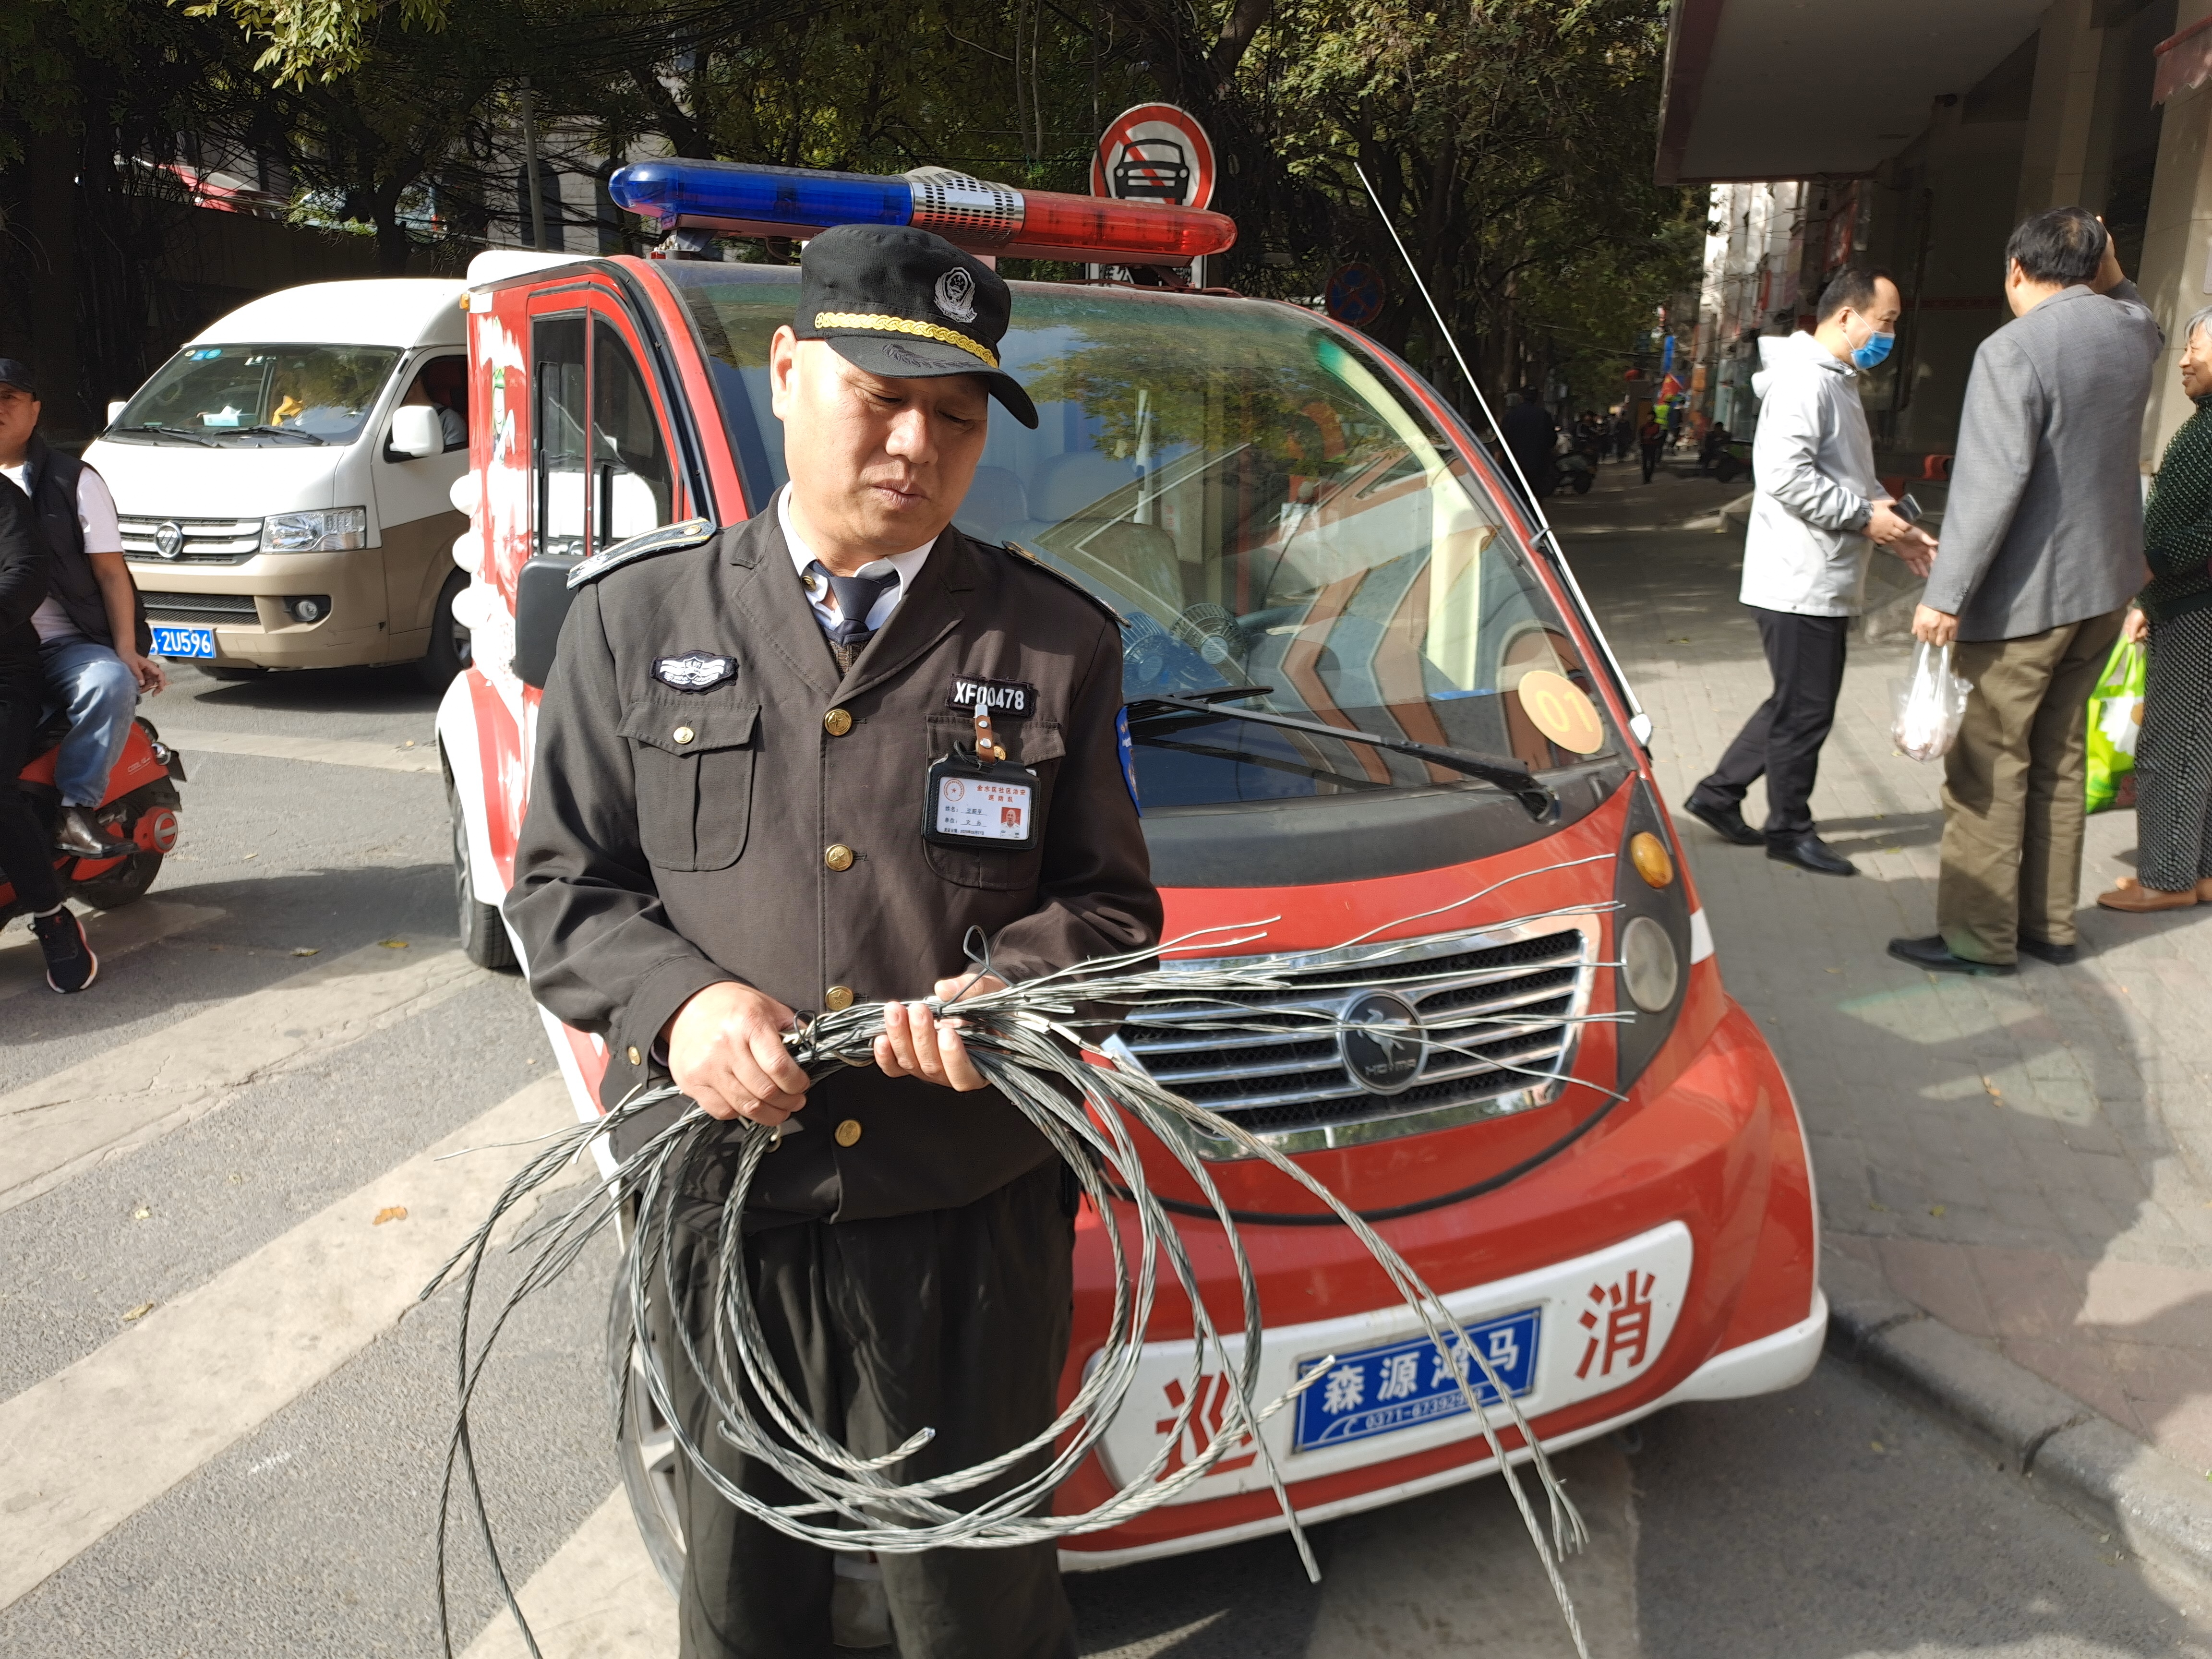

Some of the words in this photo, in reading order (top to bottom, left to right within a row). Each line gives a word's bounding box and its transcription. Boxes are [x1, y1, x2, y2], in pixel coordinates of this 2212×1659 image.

[954, 681, 1024, 710] XF00478
[1536, 690, 1594, 733] 01
[977, 785, 1026, 795] 金水区社区治安
[988, 794, 1013, 803] 巡防队
[1574, 1269, 1656, 1380] 消
